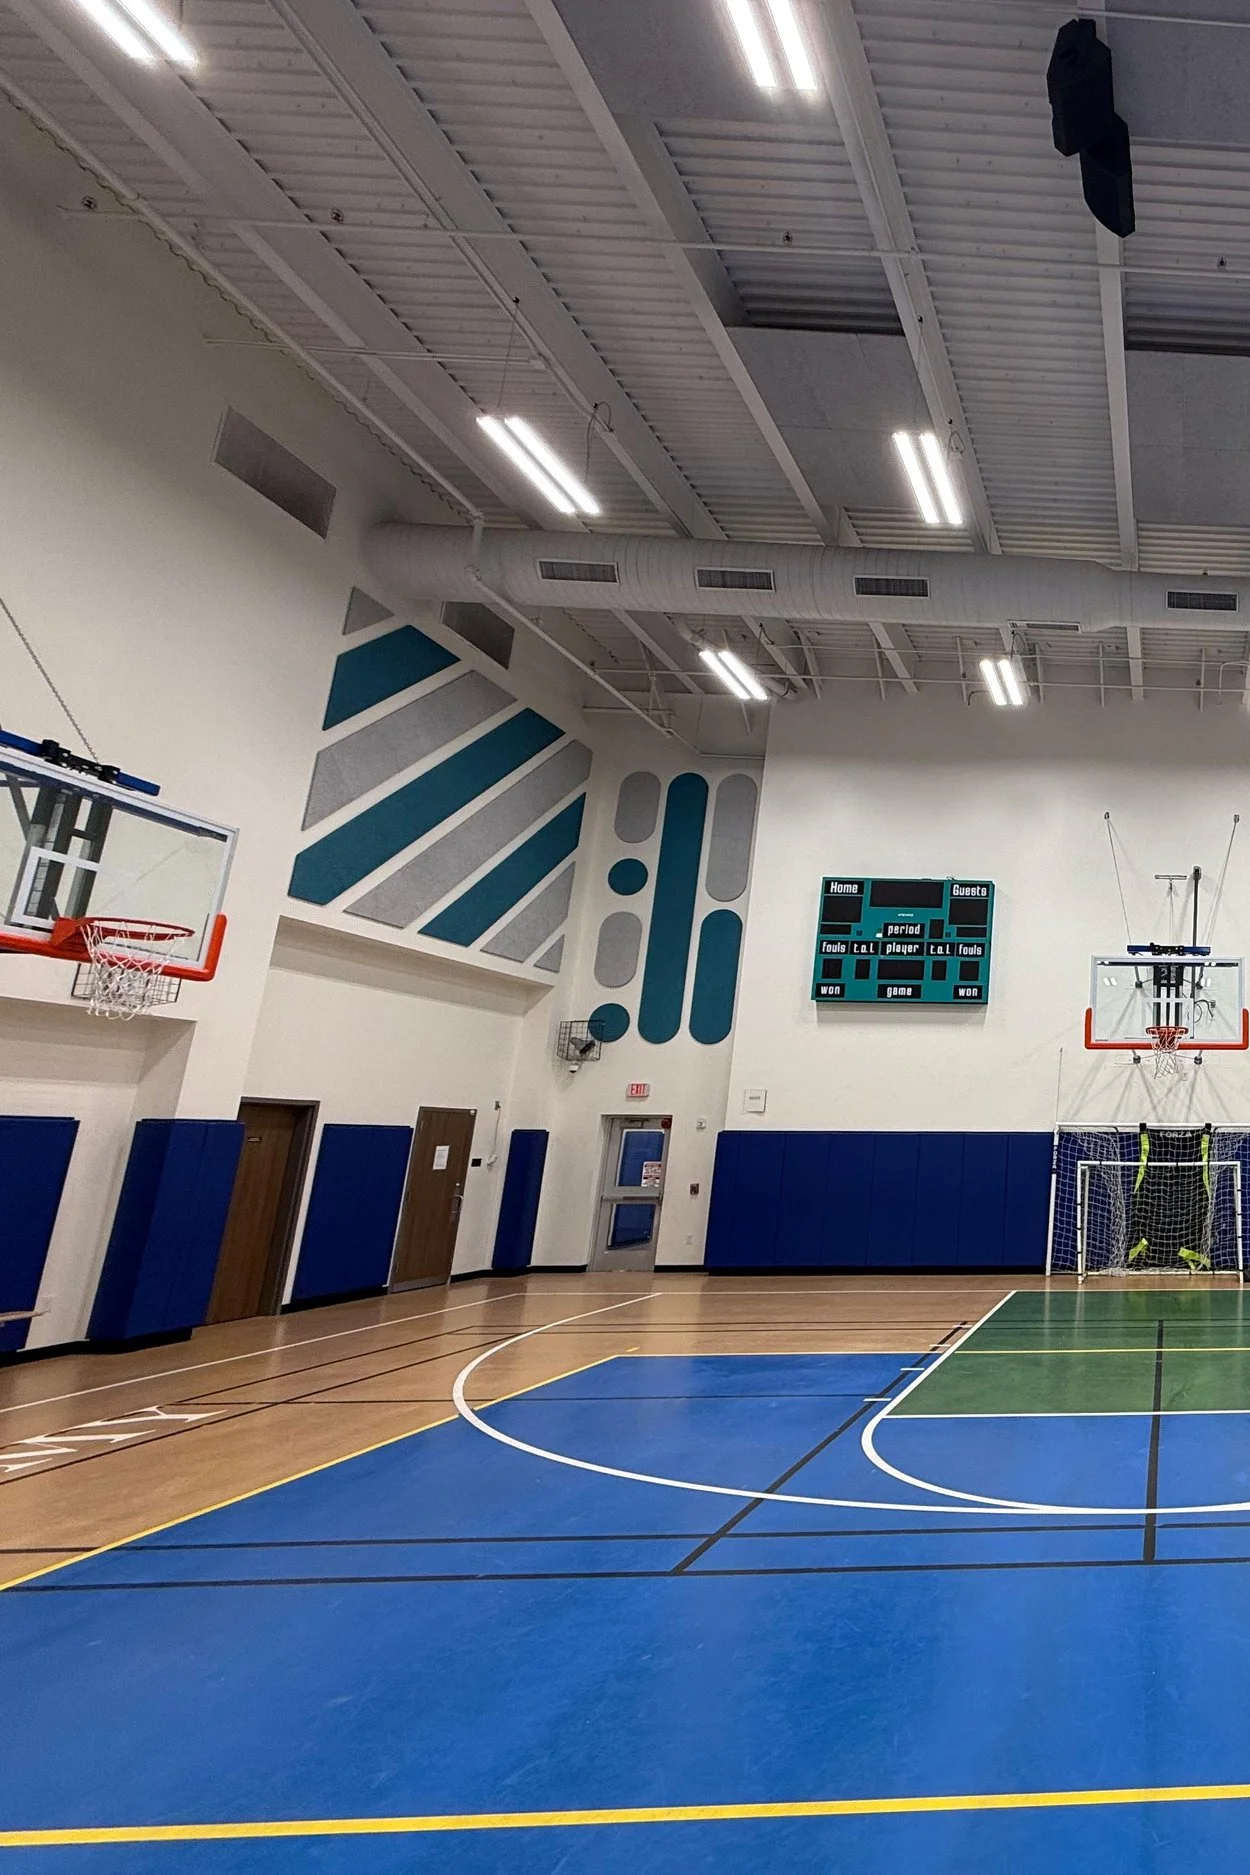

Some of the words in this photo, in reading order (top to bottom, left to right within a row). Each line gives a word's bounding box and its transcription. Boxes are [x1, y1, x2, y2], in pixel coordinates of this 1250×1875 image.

[830, 881, 859, 894] Home
[952, 884, 987, 897] Guests
[887, 923, 921, 937] period
[886, 941, 920, 956] player
[958, 943, 983, 956] fouls
[820, 985, 841, 996] won
[886, 986, 913, 999] game
[958, 987, 979, 997] won
[630, 1083, 646, 1096] EXIT
[1160, 1131, 1193, 1139] FORZA
